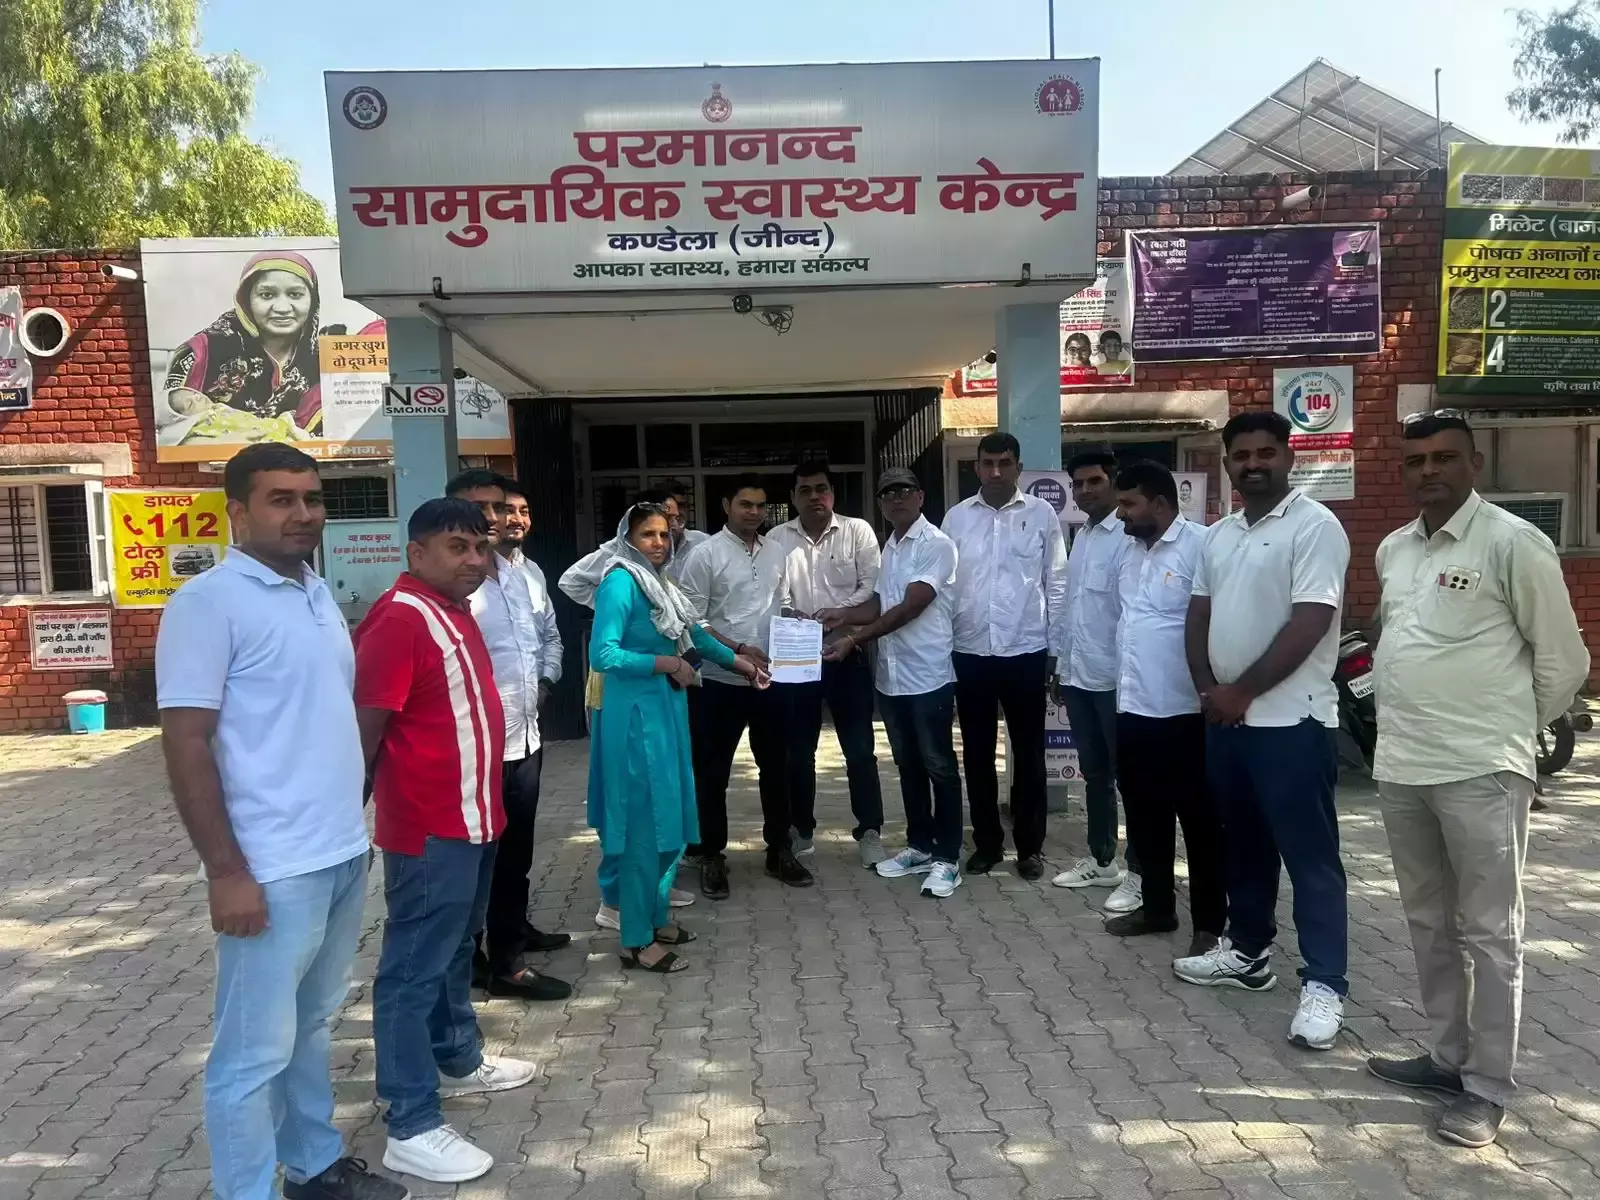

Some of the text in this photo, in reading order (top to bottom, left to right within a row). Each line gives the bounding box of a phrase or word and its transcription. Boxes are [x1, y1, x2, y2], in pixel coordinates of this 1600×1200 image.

[573, 126, 863, 169] परमानन्द
[349, 157, 1085, 248] सामुदायिक स्वास्थ्य केन्द्र
[1489, 213, 1600, 238] मिलेट (बाज
[607, 221, 836, 256] कण्डेला (जीन्द)
[1469, 244, 1524, 260] पोषक
[1528, 244, 1590, 262] अनाजों
[573, 253, 871, 279] आपका स्वास्थ्य, हमारा संकल्प
[1097, 260, 1125, 270] रियाणा
[1448, 265, 1501, 283] प्रमुख
[1505, 266, 1571, 280] स्वास्थ्य
[1087, 288, 1103, 298] सिंह
[1510, 290, 1545, 298] Gluten Free
[1489, 289, 1507, 328] 2
[332, 341, 386, 354] अगर खुश
[1486, 335, 1505, 373] 4
[333, 355, 347, 367] तो
[367, 354, 377, 366] में
[1544, 381, 1567, 392] कृषि
[1570, 381, 1591, 391] तथा
[386, 406, 446, 414] SMOKING
[1305, 393, 1331, 411] 104
[144, 495, 193, 508] डायल
[147, 512, 219, 538] 112
[123, 541, 166, 560] टोल
[130, 561, 160, 580] फ्री
[77, 632, 88, 641] की
[53, 645, 63, 654] की
[65, 645, 83, 654] जाती
